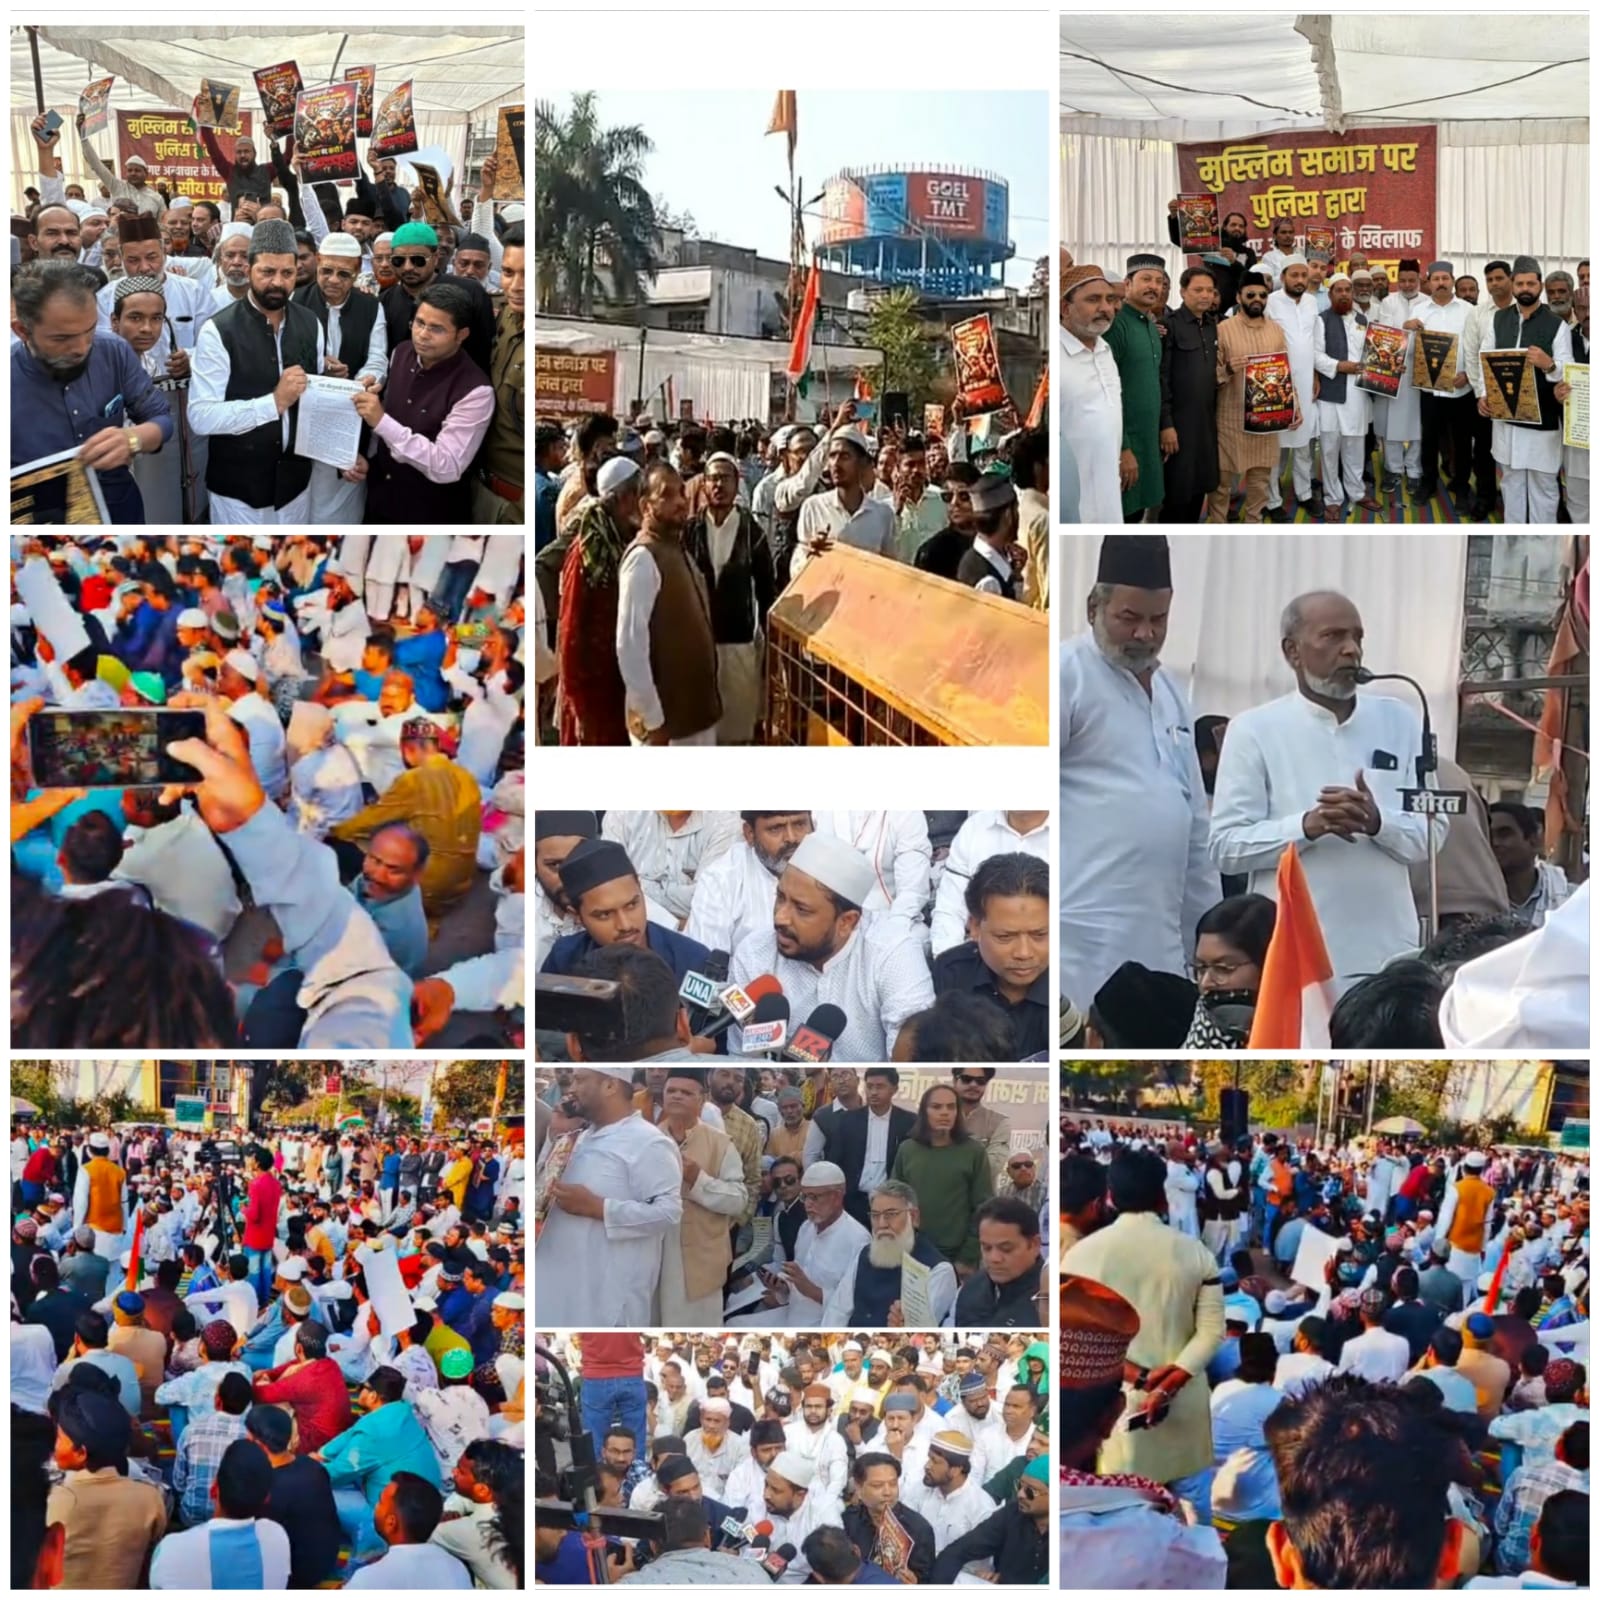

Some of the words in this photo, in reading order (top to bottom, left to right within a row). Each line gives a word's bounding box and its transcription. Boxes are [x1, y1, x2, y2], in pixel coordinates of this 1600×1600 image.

[126, 115, 179, 139] मुस्लिम
[154, 138, 190, 159] पुलिस
[1196, 145, 1294, 192] मुस्लिम
[1297, 145, 1378, 176] समाज
[1381, 143, 1419, 172] पर
[926, 179, 970, 197] GOEL
[930, 199, 967, 217] TMT
[1250, 185, 1319, 228] पुलिस
[1321, 187, 1367, 219] द्वारा
[1340, 226, 1357, 249] के
[1359, 225, 1424, 249] खिलाफ
[552, 355, 589, 371] समाज
[591, 358, 608, 373] पर
[536, 372, 560, 391] लिस
[1410, 790, 1462, 813] सीरत
[684, 975, 712, 1004] UNA
